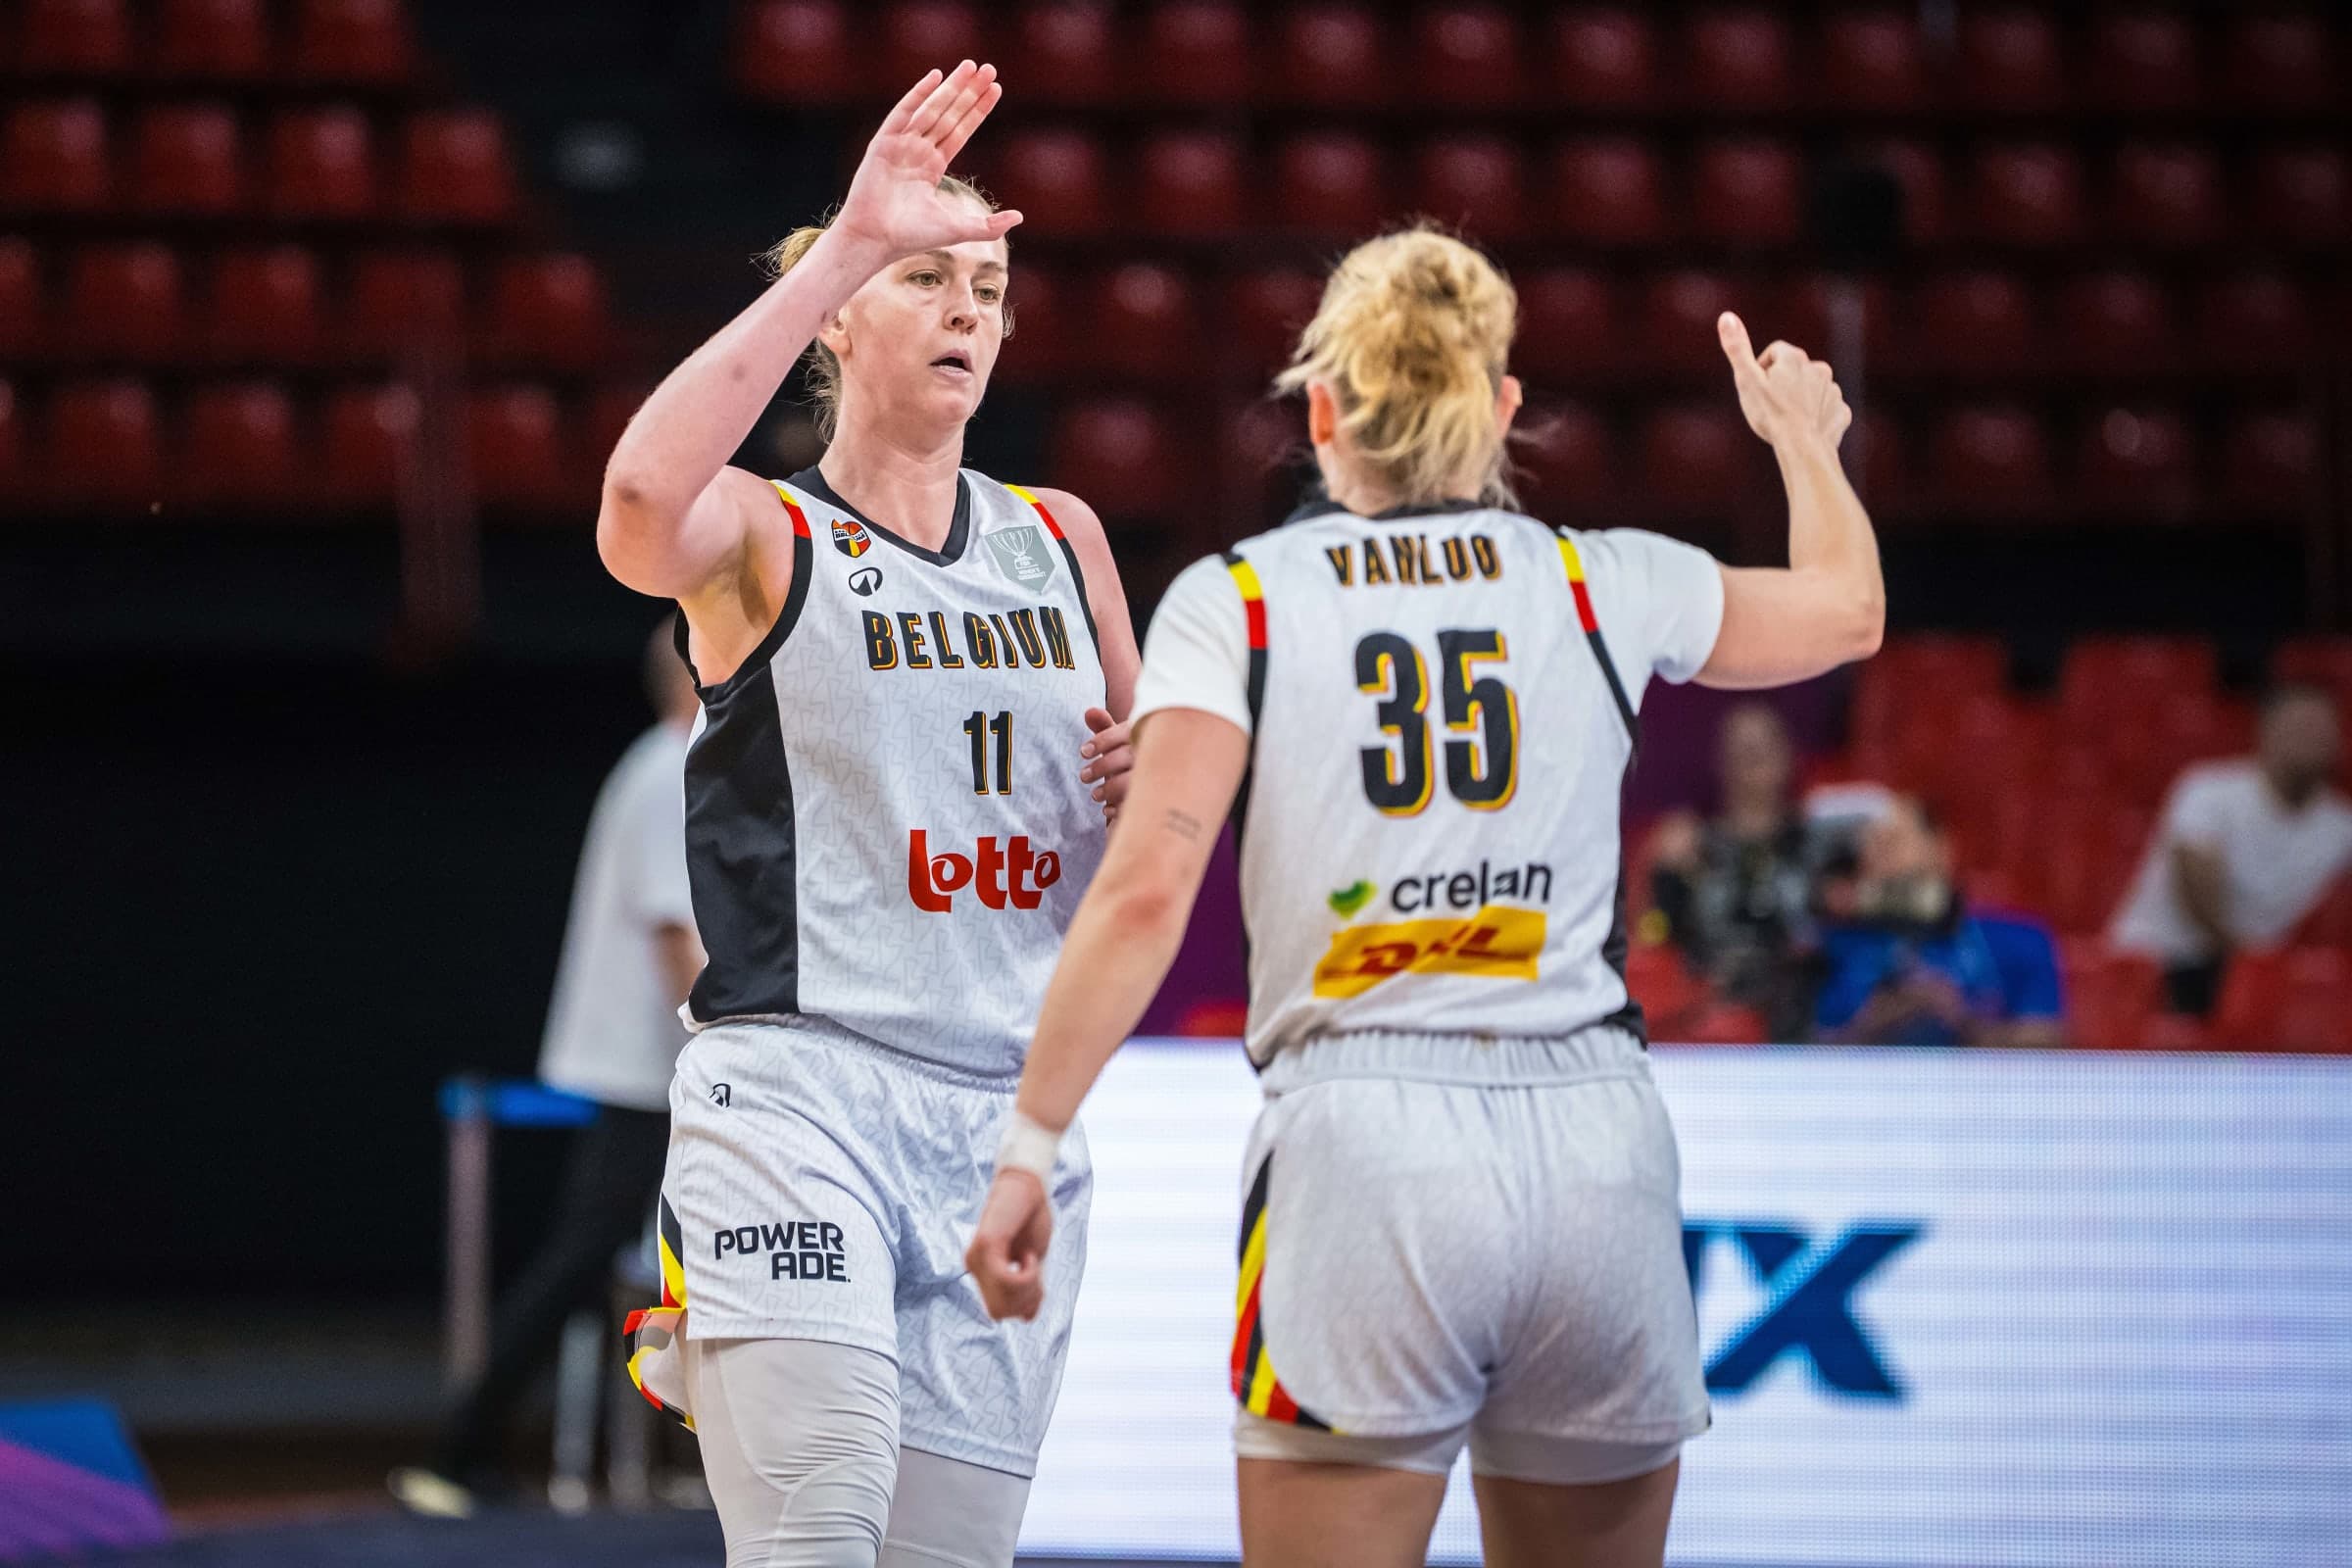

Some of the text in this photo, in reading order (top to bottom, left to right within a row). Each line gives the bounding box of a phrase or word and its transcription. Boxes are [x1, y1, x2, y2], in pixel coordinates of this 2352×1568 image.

[1325, 534, 1502, 586] VANLOO
[861, 606, 1075, 670] BELGIUM
[963, 710, 1011, 795] 11
[1354, 630, 1519, 819] 35
[908, 829, 1061, 913] lotto
[1391, 858, 1552, 912] crelan
[714, 1221, 845, 1260] POWER
